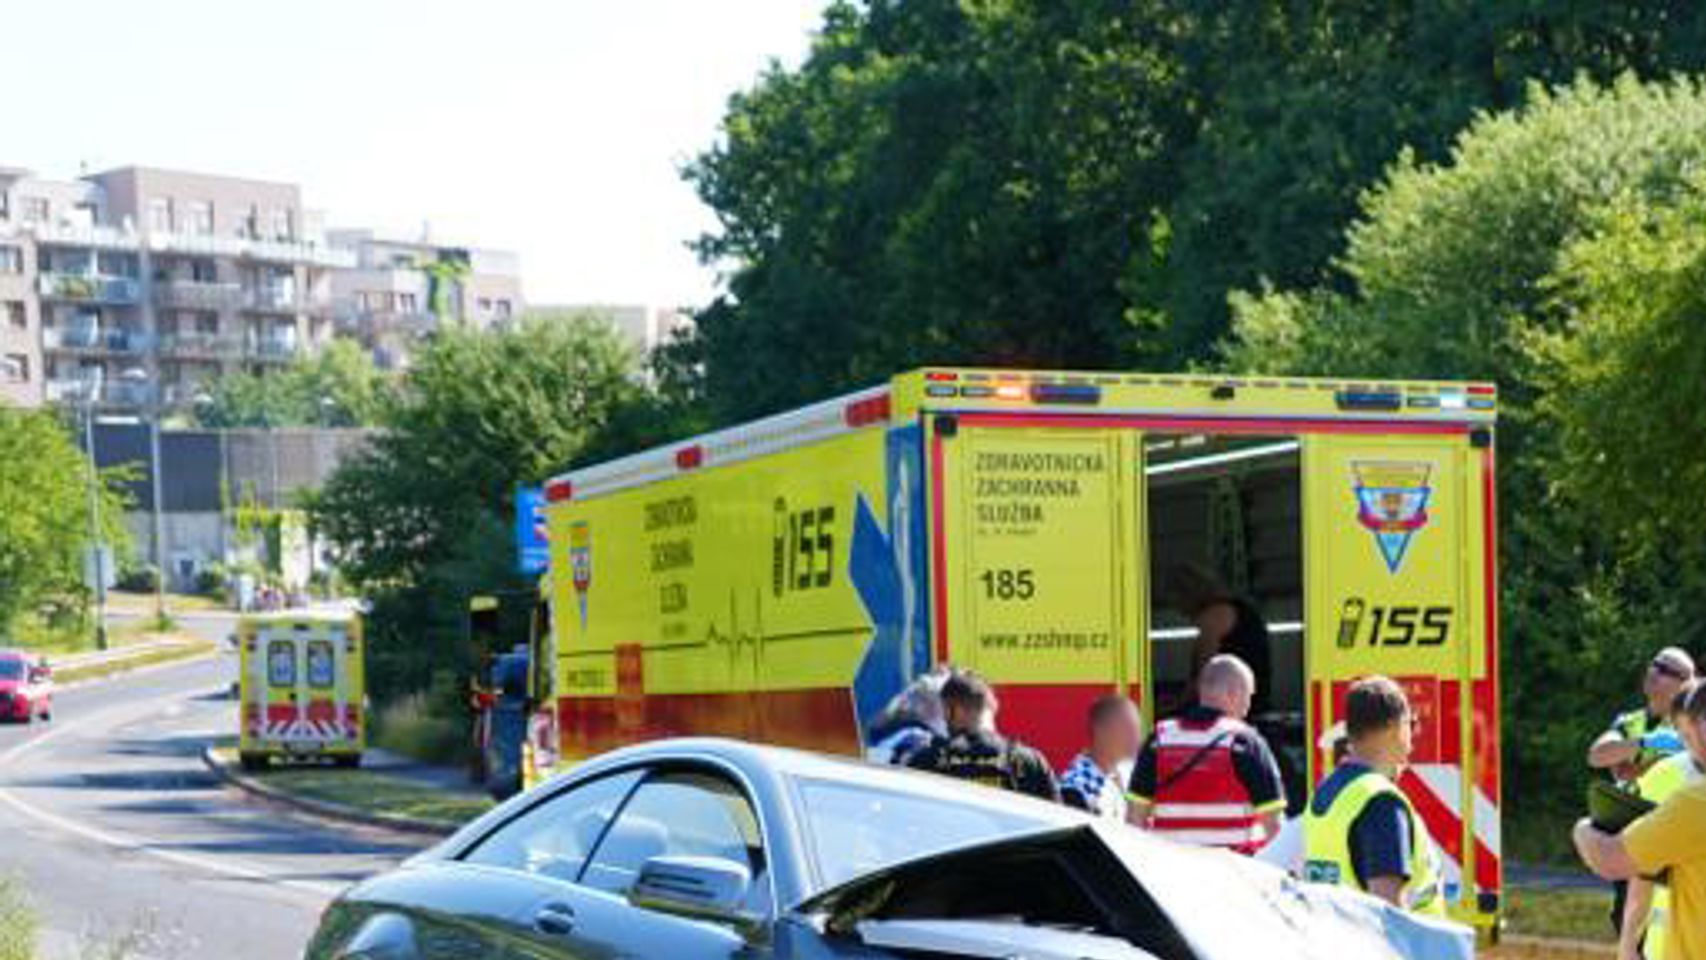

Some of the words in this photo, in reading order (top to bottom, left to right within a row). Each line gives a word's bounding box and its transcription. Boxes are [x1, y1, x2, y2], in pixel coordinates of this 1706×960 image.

[788, 505, 835, 590] 155
[979, 569, 1035, 600] 185
[1369, 606, 1453, 646] 155
